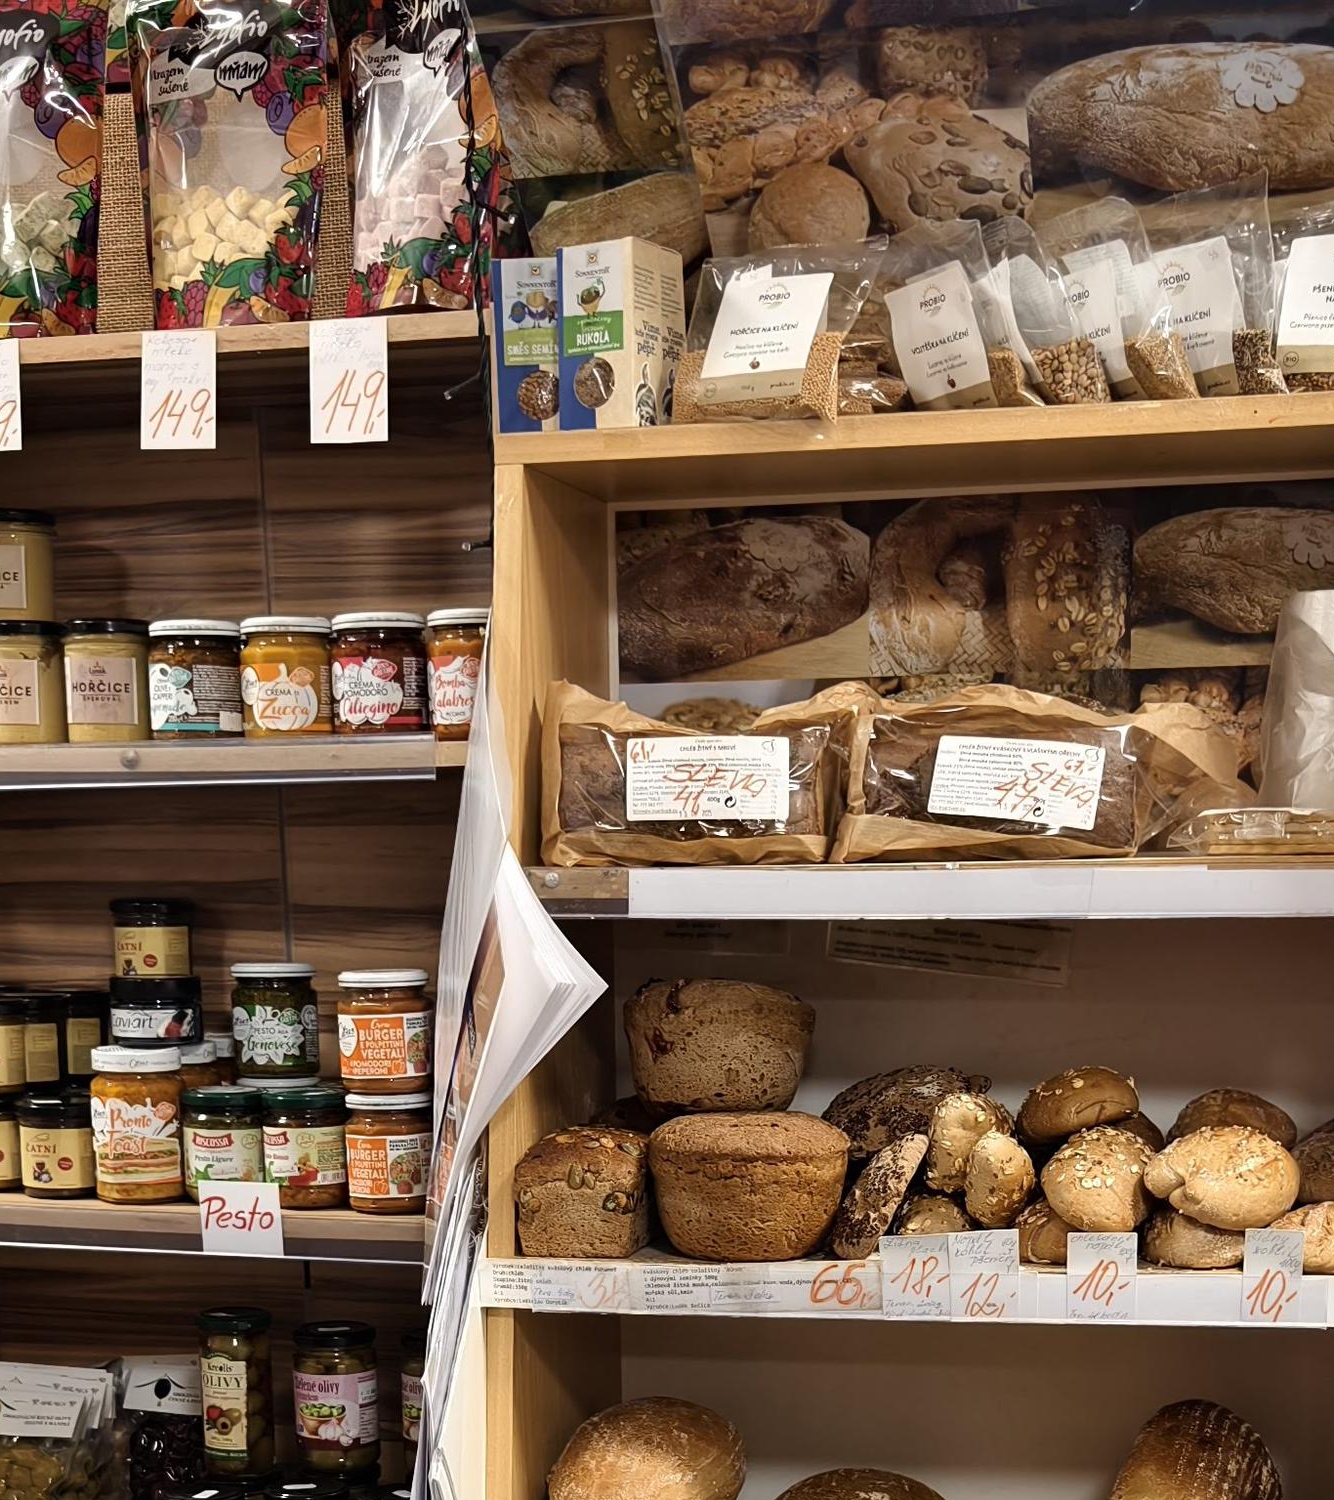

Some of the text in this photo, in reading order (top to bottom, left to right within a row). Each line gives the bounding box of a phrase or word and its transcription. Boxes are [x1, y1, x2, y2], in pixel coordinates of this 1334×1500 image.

[759, 291, 791, 303] PROBIO
[576, 330, 610, 346] RUKOLA
[73, 680, 130, 694] HOŘČICE
[266, 688, 291, 697] CREMA
[359, 1028, 403, 1042] BURGER
[361, 1048, 405, 1060] VEGETALI
[200, 1194, 275, 1232] Pesto
